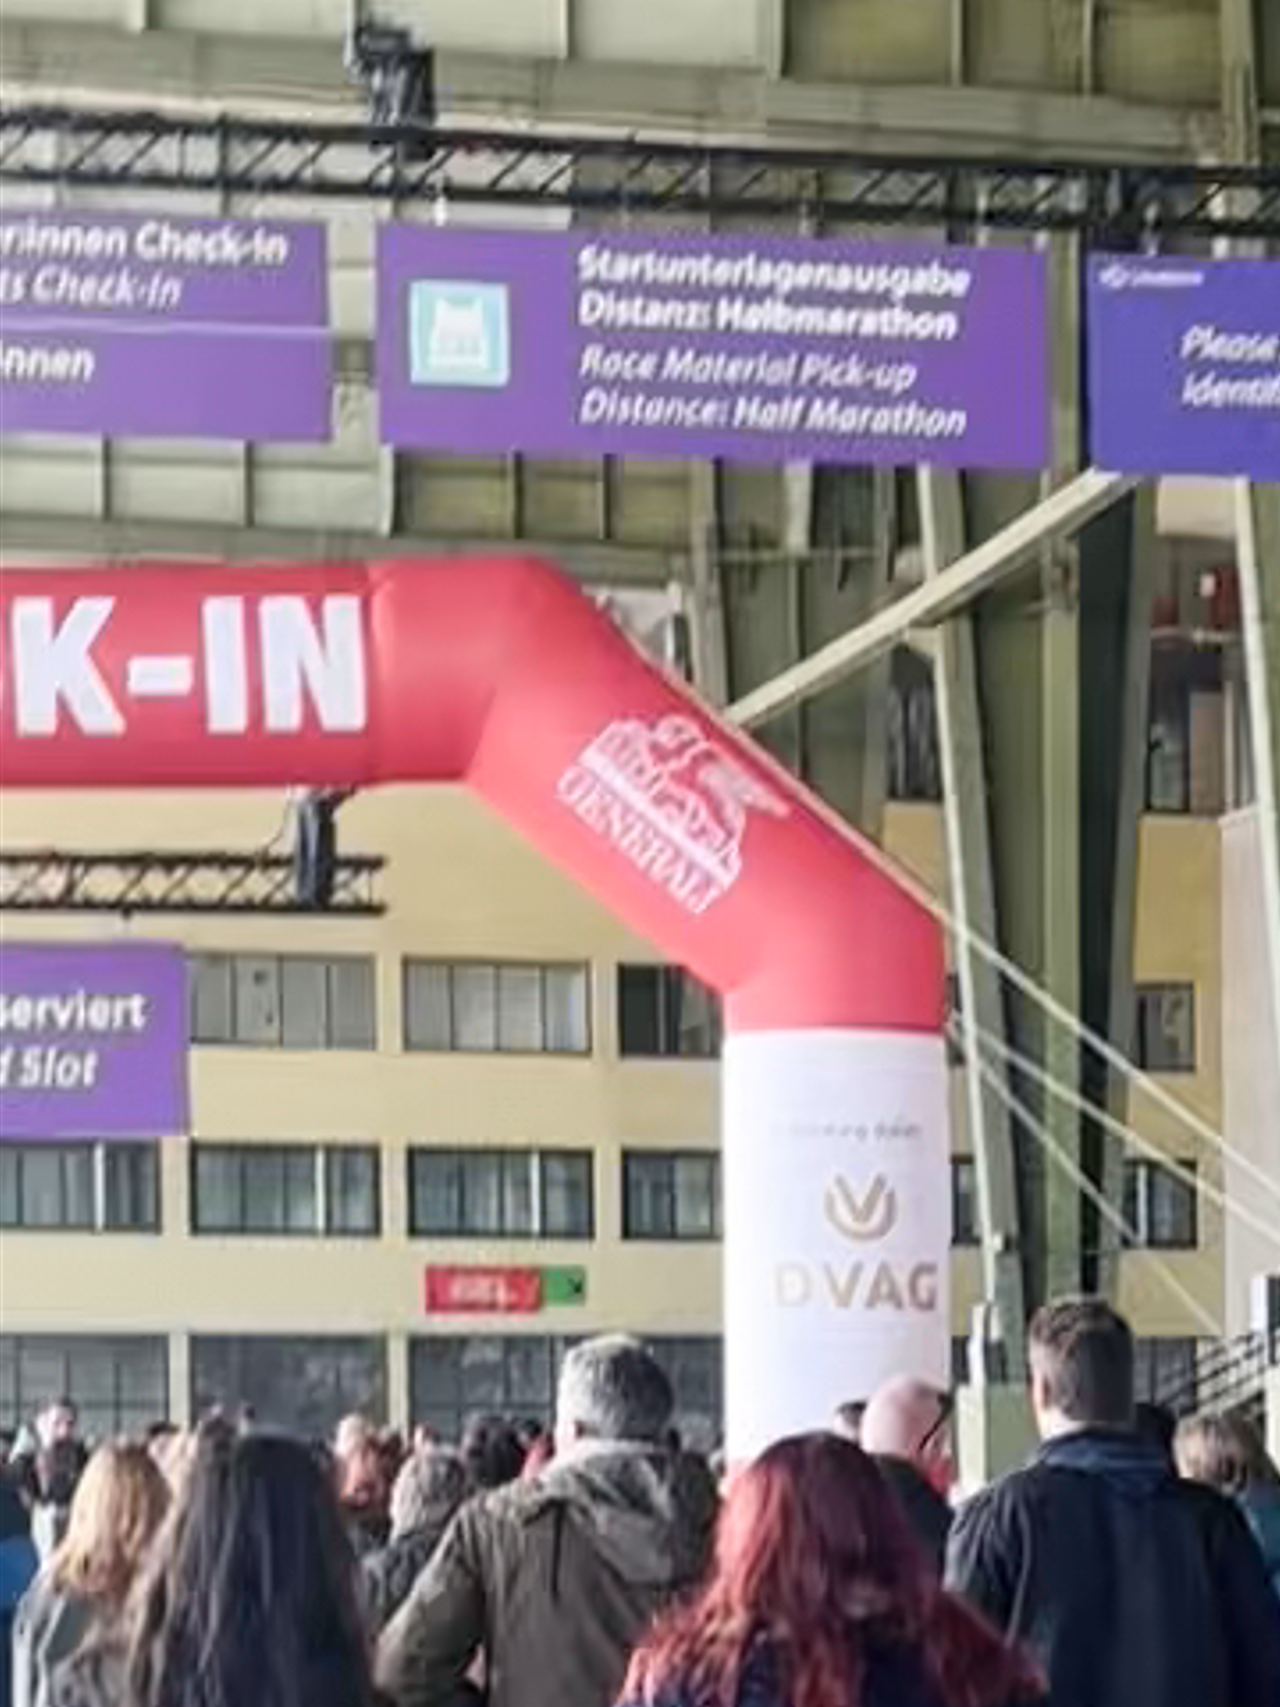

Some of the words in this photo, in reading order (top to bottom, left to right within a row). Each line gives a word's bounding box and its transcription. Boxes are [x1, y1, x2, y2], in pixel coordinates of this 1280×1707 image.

[716, 295, 958, 341] Halbmarathon
[1180, 324, 1279, 362] Please
[579, 344, 659, 381] Race
[661, 349, 798, 387] Material
[799, 352, 918, 395] Pick-up
[580, 388, 730, 427] Distance:
[734, 396, 805, 432] Half
[806, 398, 968, 438] Marathon
[12, 594, 368, 736] K-IN
[20, 1044, 99, 1089] Slot
[775, 1259, 939, 1312] DVAG
